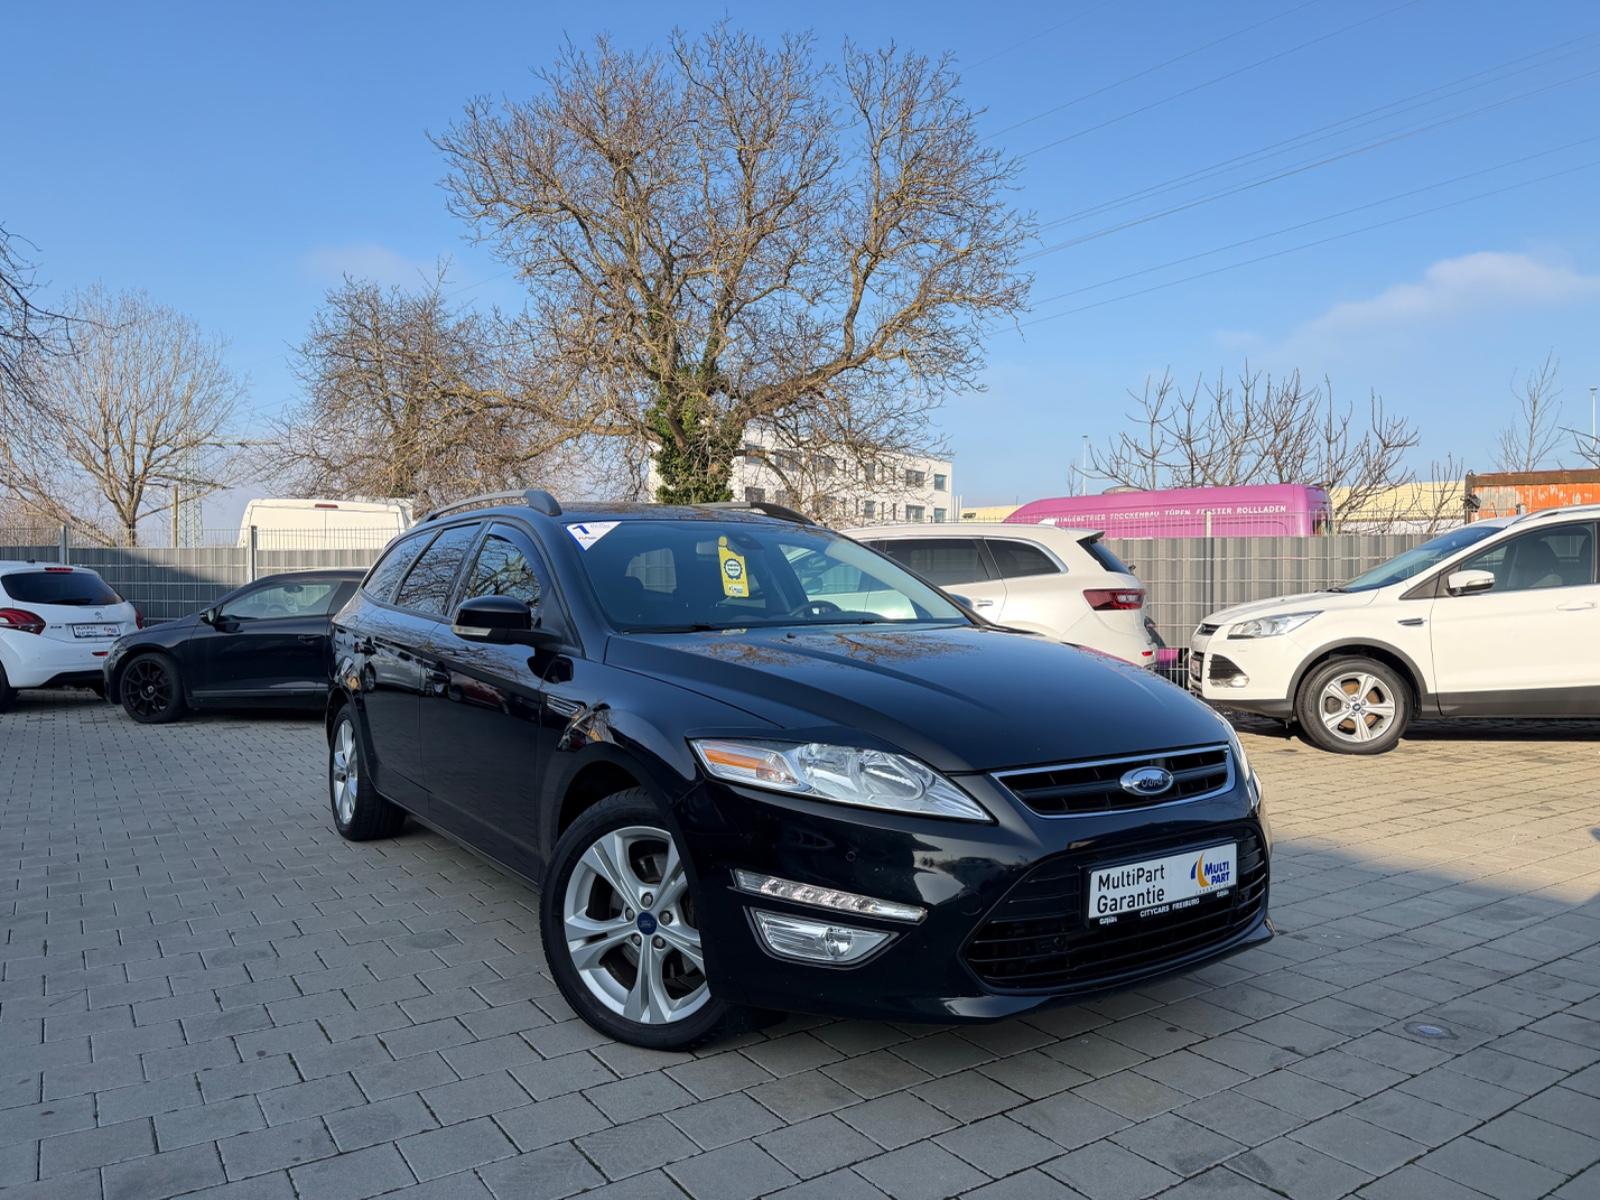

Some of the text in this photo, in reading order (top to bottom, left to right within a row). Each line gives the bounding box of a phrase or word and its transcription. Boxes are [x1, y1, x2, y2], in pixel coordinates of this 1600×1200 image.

[1141, 775, 1163, 788] Ford
[1204, 861, 1230, 875] MULTI
[1098, 864, 1165, 892] MultiPart
[1211, 871, 1231, 886] PART
[1097, 885, 1165, 914] Garantie
[1140, 897, 1200, 918] CITYCARS FREIBURG
